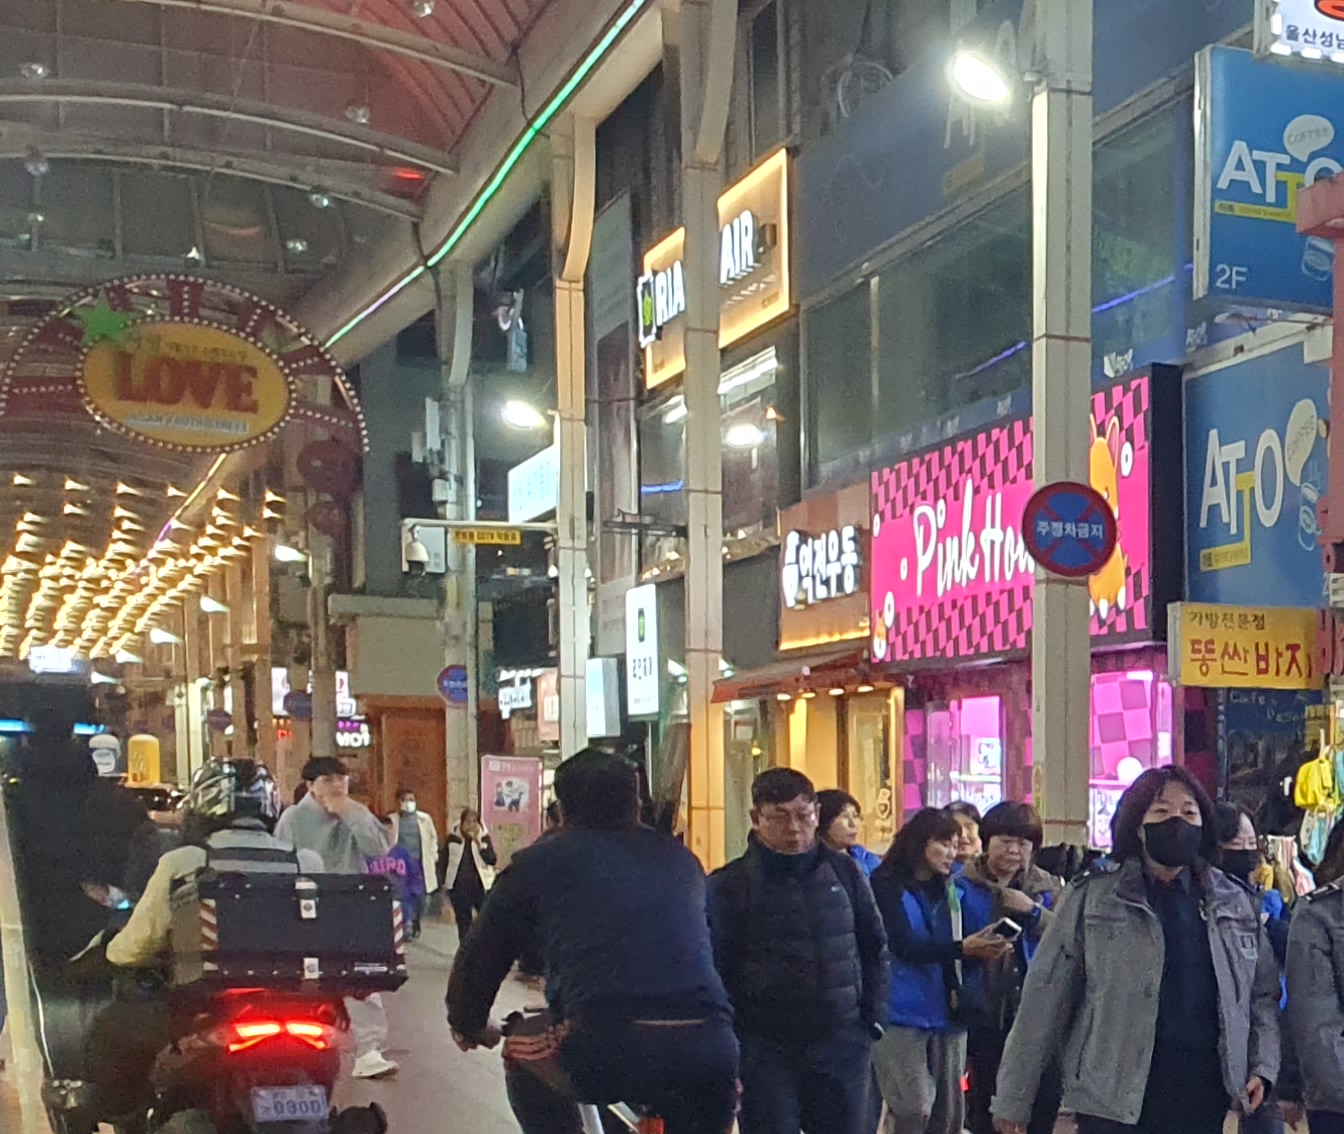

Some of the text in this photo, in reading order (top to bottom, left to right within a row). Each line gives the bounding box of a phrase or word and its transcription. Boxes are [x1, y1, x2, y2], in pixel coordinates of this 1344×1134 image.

[1215, 264, 1248, 289] 2F
[113, 351, 258, 414] LOVE
[913, 478, 980, 598] Pink
[1036, 521, 1104, 541] 주정차금지
[1188, 612, 1266, 631] 가방전문점
